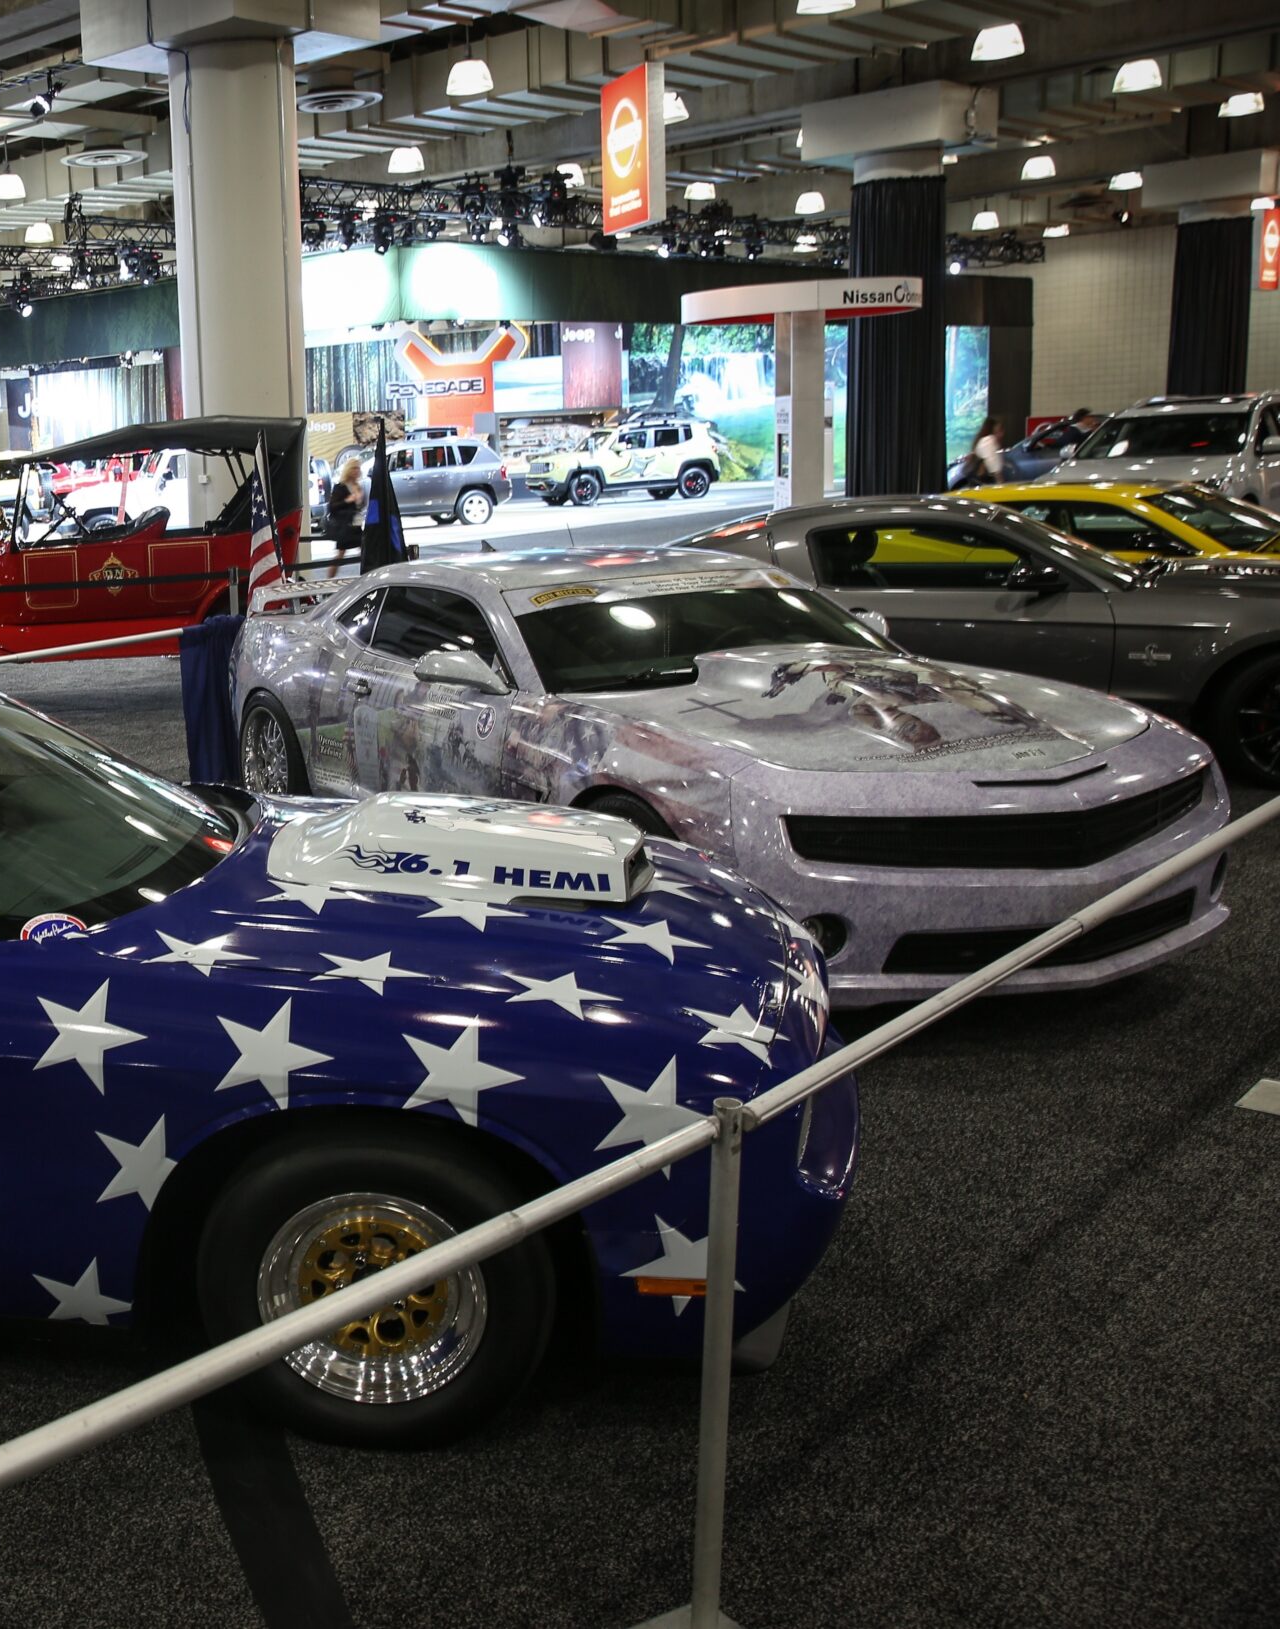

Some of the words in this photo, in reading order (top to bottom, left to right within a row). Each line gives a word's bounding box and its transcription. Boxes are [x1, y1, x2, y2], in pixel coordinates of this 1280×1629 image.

[562, 327, 595, 343] Jeep
[387, 378, 483, 399] RENEGADE
[399, 854, 471, 876] 6.1
[493, 866, 611, 893] HEMI
